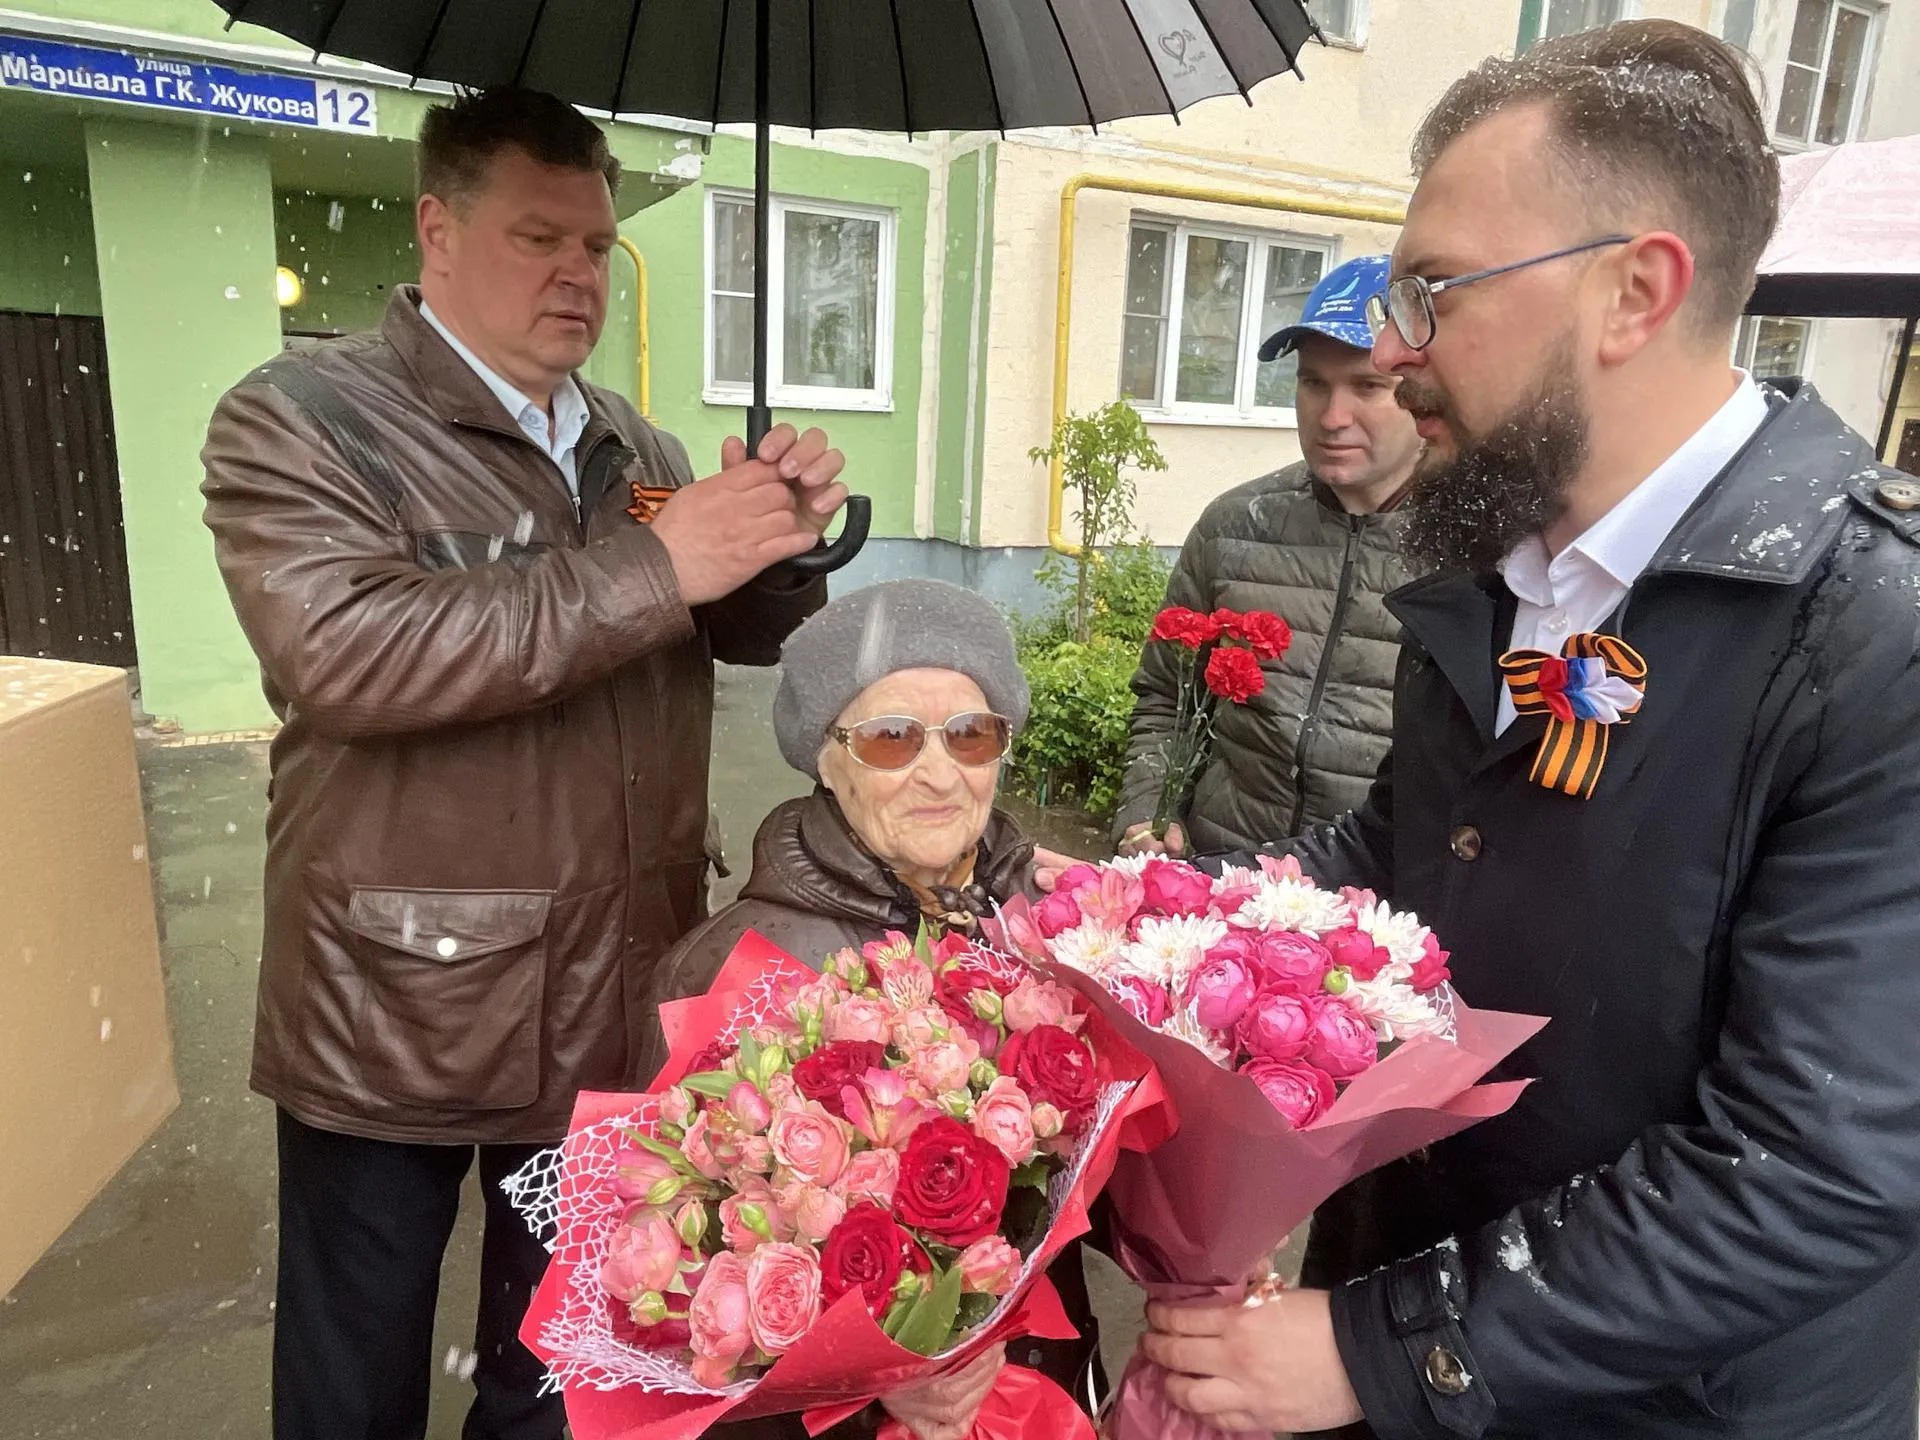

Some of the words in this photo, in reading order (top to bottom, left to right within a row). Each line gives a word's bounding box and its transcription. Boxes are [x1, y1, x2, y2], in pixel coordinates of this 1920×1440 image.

[134, 57, 192, 77] улица
[1, 55, 147, 96] Маршала
[154, 75, 203, 104] Г.К.
[208, 82, 316, 119] Жукова
[322, 88, 371, 127] 12
